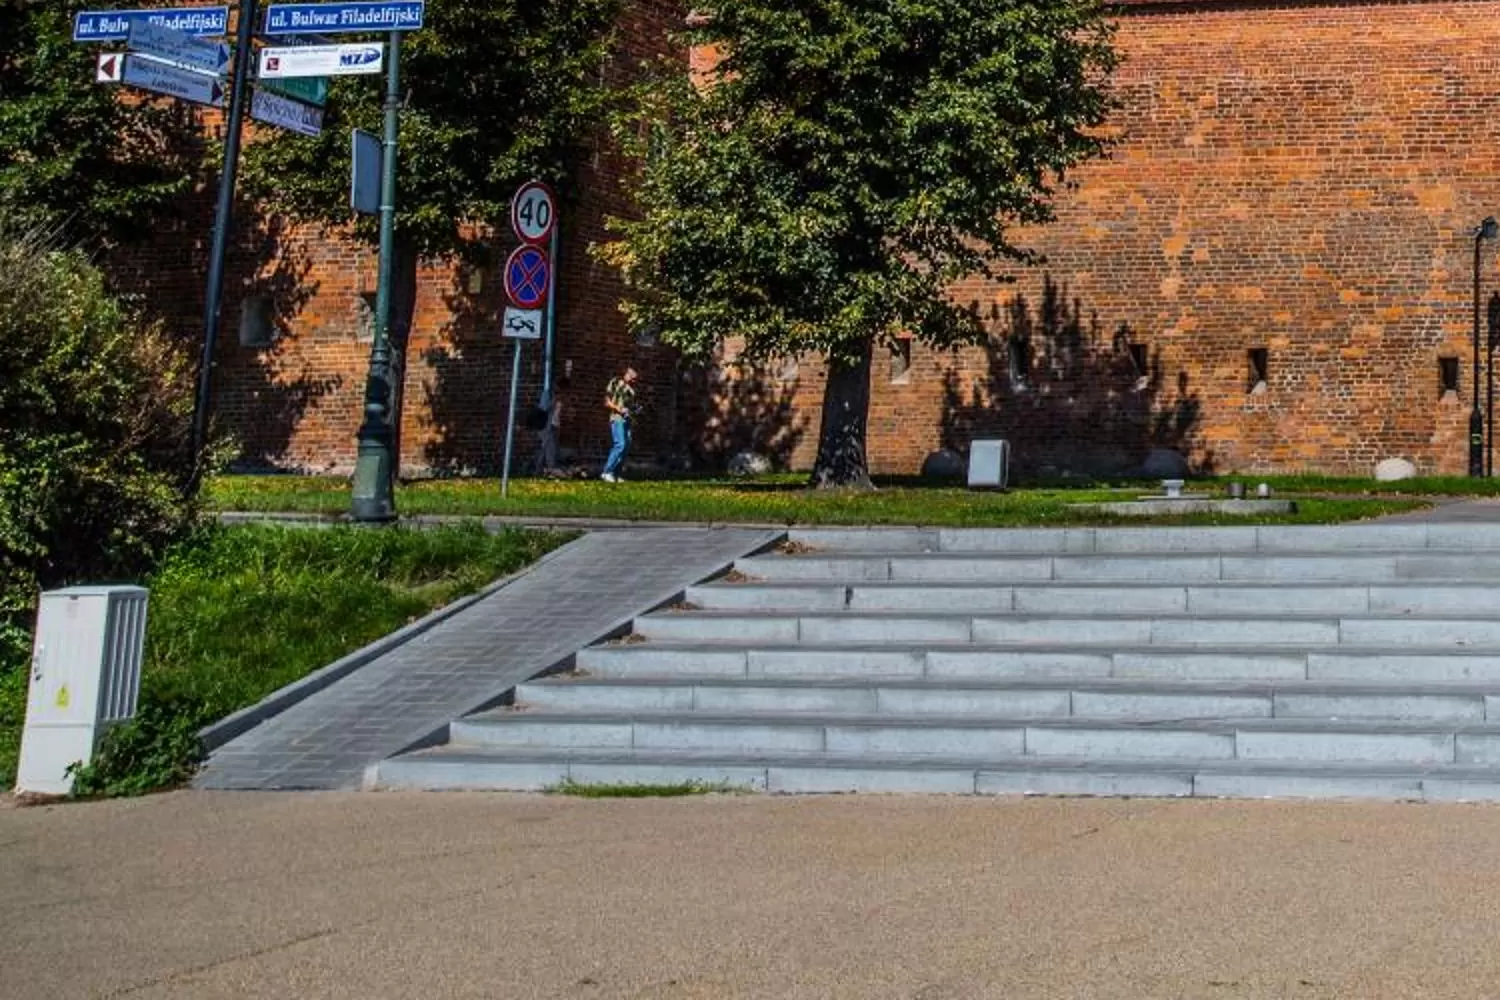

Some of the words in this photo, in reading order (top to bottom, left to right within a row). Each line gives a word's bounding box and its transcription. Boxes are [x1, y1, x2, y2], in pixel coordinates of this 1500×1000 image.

[100, 17, 129, 32] Bulw
[271, 10, 288, 27] ul.
[291, 10, 338, 27] Bulwar
[340, 6, 419, 28] Filadelfijski
[520, 197, 549, 229] 40
